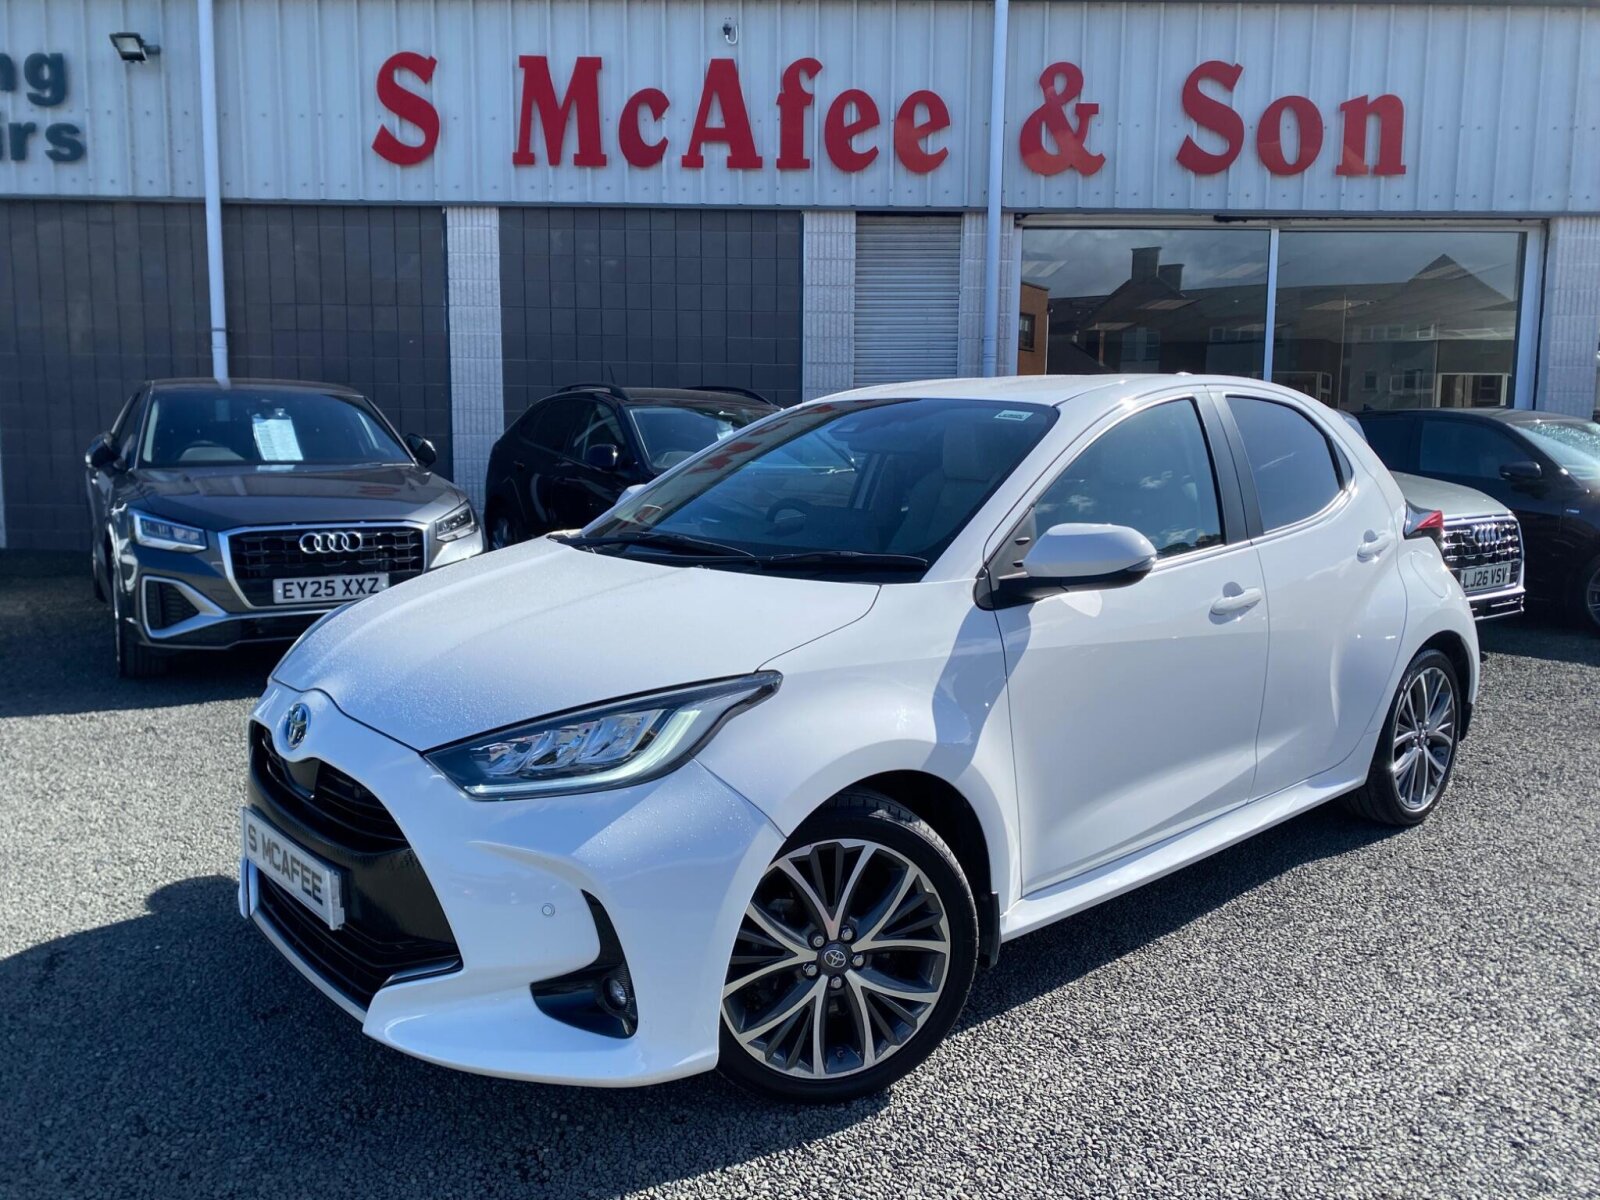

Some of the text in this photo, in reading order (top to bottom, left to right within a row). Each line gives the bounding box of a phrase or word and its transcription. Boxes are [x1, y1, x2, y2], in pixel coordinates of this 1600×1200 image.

[373, 53, 1405, 176] S McAfee & Son
[282, 577, 379, 599] EY25 XXZ
[1463, 570, 1488, 588] LJ26
[248, 824, 323, 906] S MCAFEE
